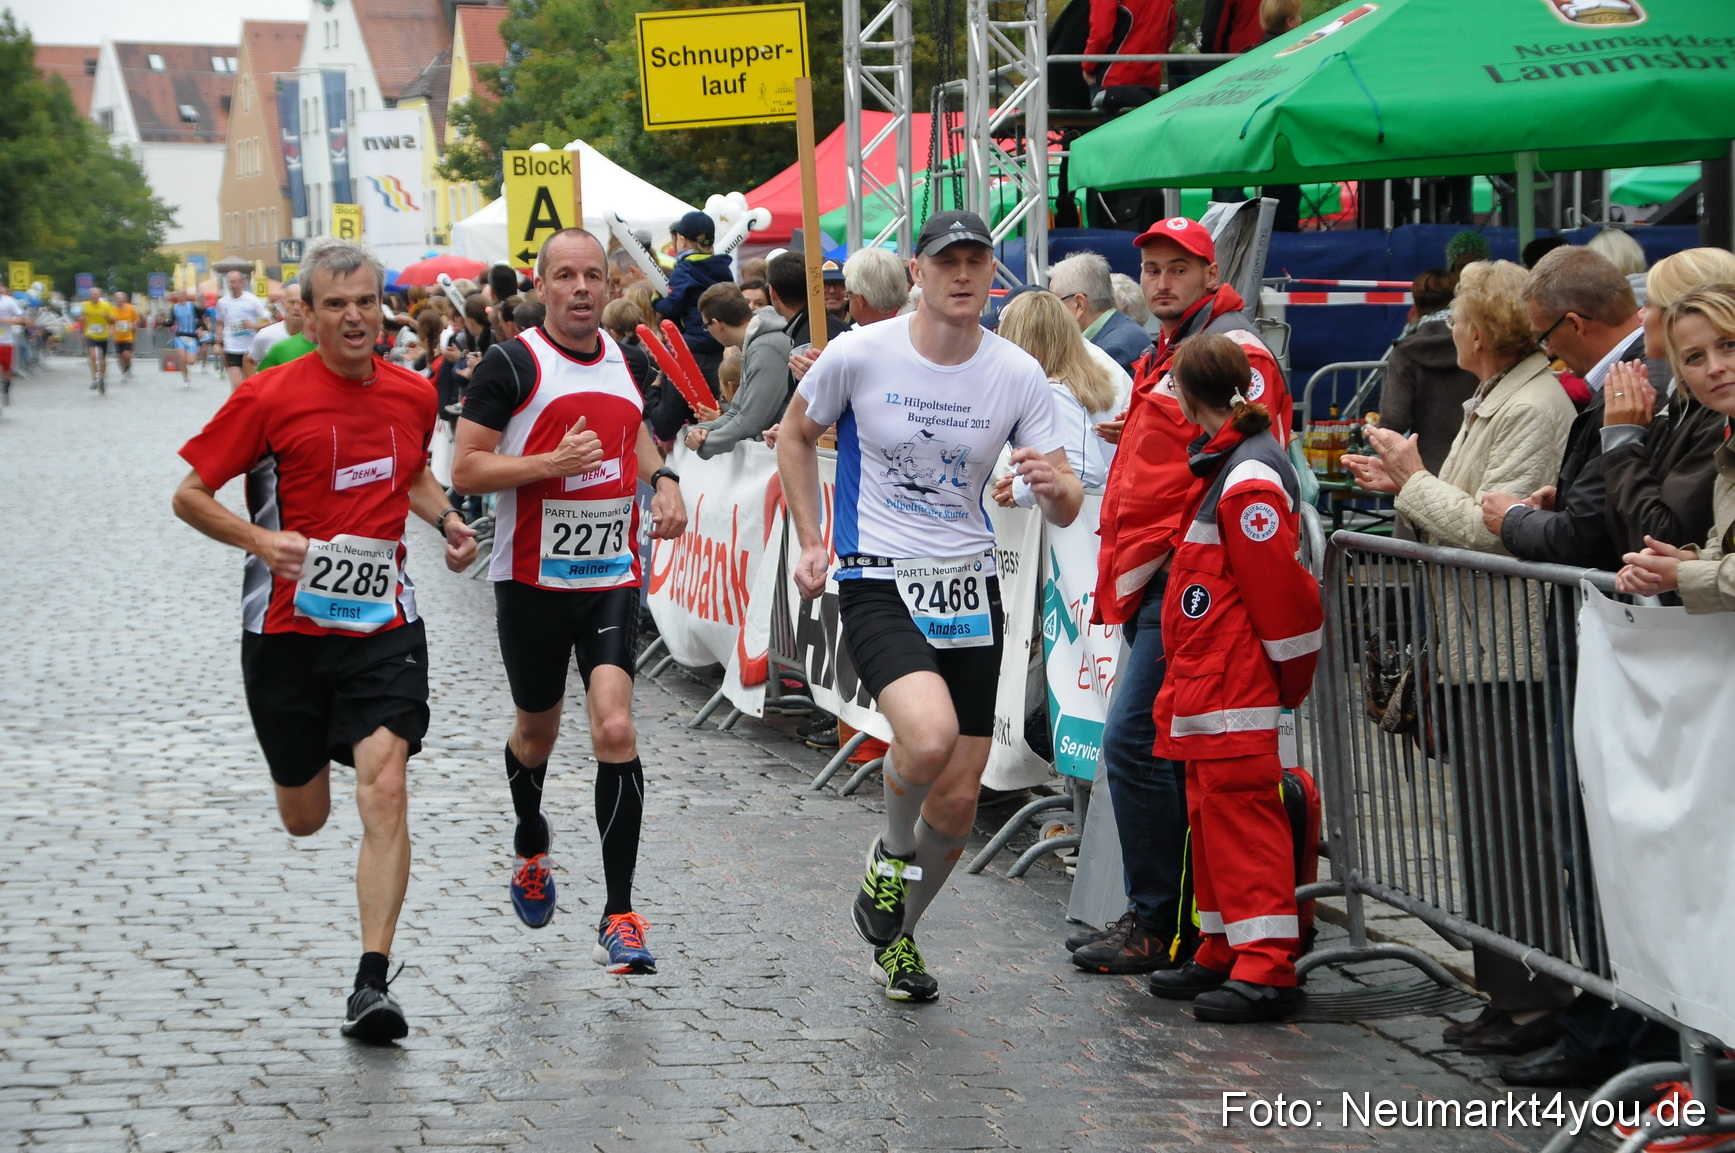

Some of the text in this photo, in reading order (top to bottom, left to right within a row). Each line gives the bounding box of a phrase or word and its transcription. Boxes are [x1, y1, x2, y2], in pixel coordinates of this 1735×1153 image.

[651, 43, 793, 68] Schnupper-
[1482, 50, 1735, 84] Lammsbr
[702, 72, 747, 96] lauf
[513, 155, 572, 176] Block
[335, 205, 359, 215] Block
[524, 186, 564, 241] A
[886, 393, 971, 413] 12. Hilpoltsteiner
[907, 412, 990, 429] Burgfestlauf 2012
[352, 467, 377, 480] DEHN
[581, 467, 607, 482] DEHN
[545, 508, 621, 519] PARTL Neumarkt
[1244, 505, 1274, 520] DEUTSCHES
[552, 519, 624, 556] 2273
[344, 545, 385, 559] Neumarkt
[309, 556, 390, 598] 2285
[568, 564, 610, 575] Rainer
[897, 564, 971, 578] PARTL Neumarkt
[908, 576, 979, 613] 2468
[329, 603, 361, 619] Ernst
[928, 621, 971, 635] Andreas
[1060, 735, 1100, 762] Service
